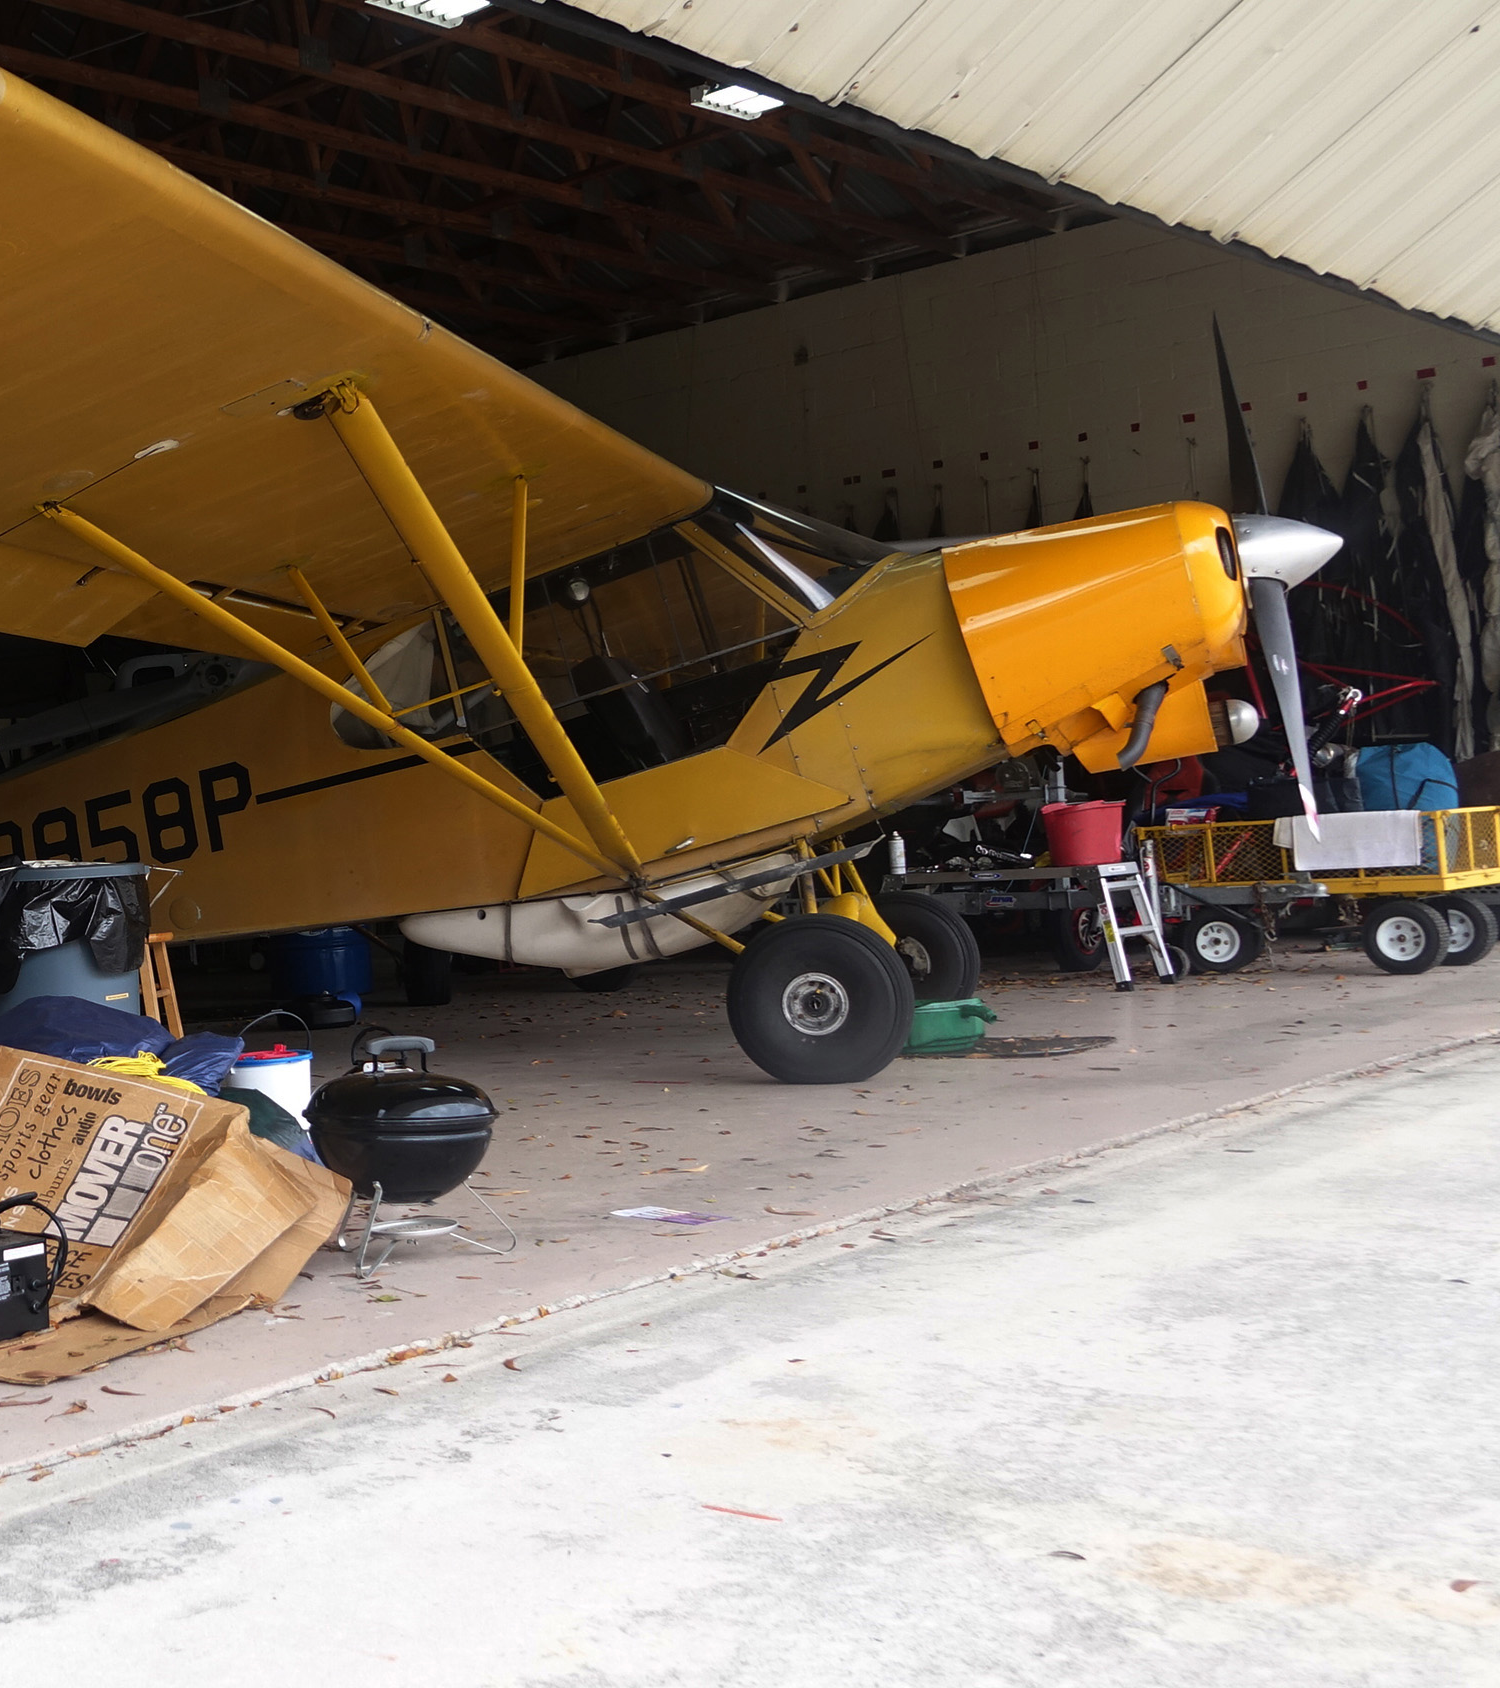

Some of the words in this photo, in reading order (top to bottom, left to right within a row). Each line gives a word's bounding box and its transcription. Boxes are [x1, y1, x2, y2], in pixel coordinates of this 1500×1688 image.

[33, 1073, 61, 1117] gear
[62, 1078, 122, 1105] bowls
[26, 1104, 77, 1180] clothes
[71, 1111, 97, 1146] audio
[44, 1115, 146, 1241] MOVER
